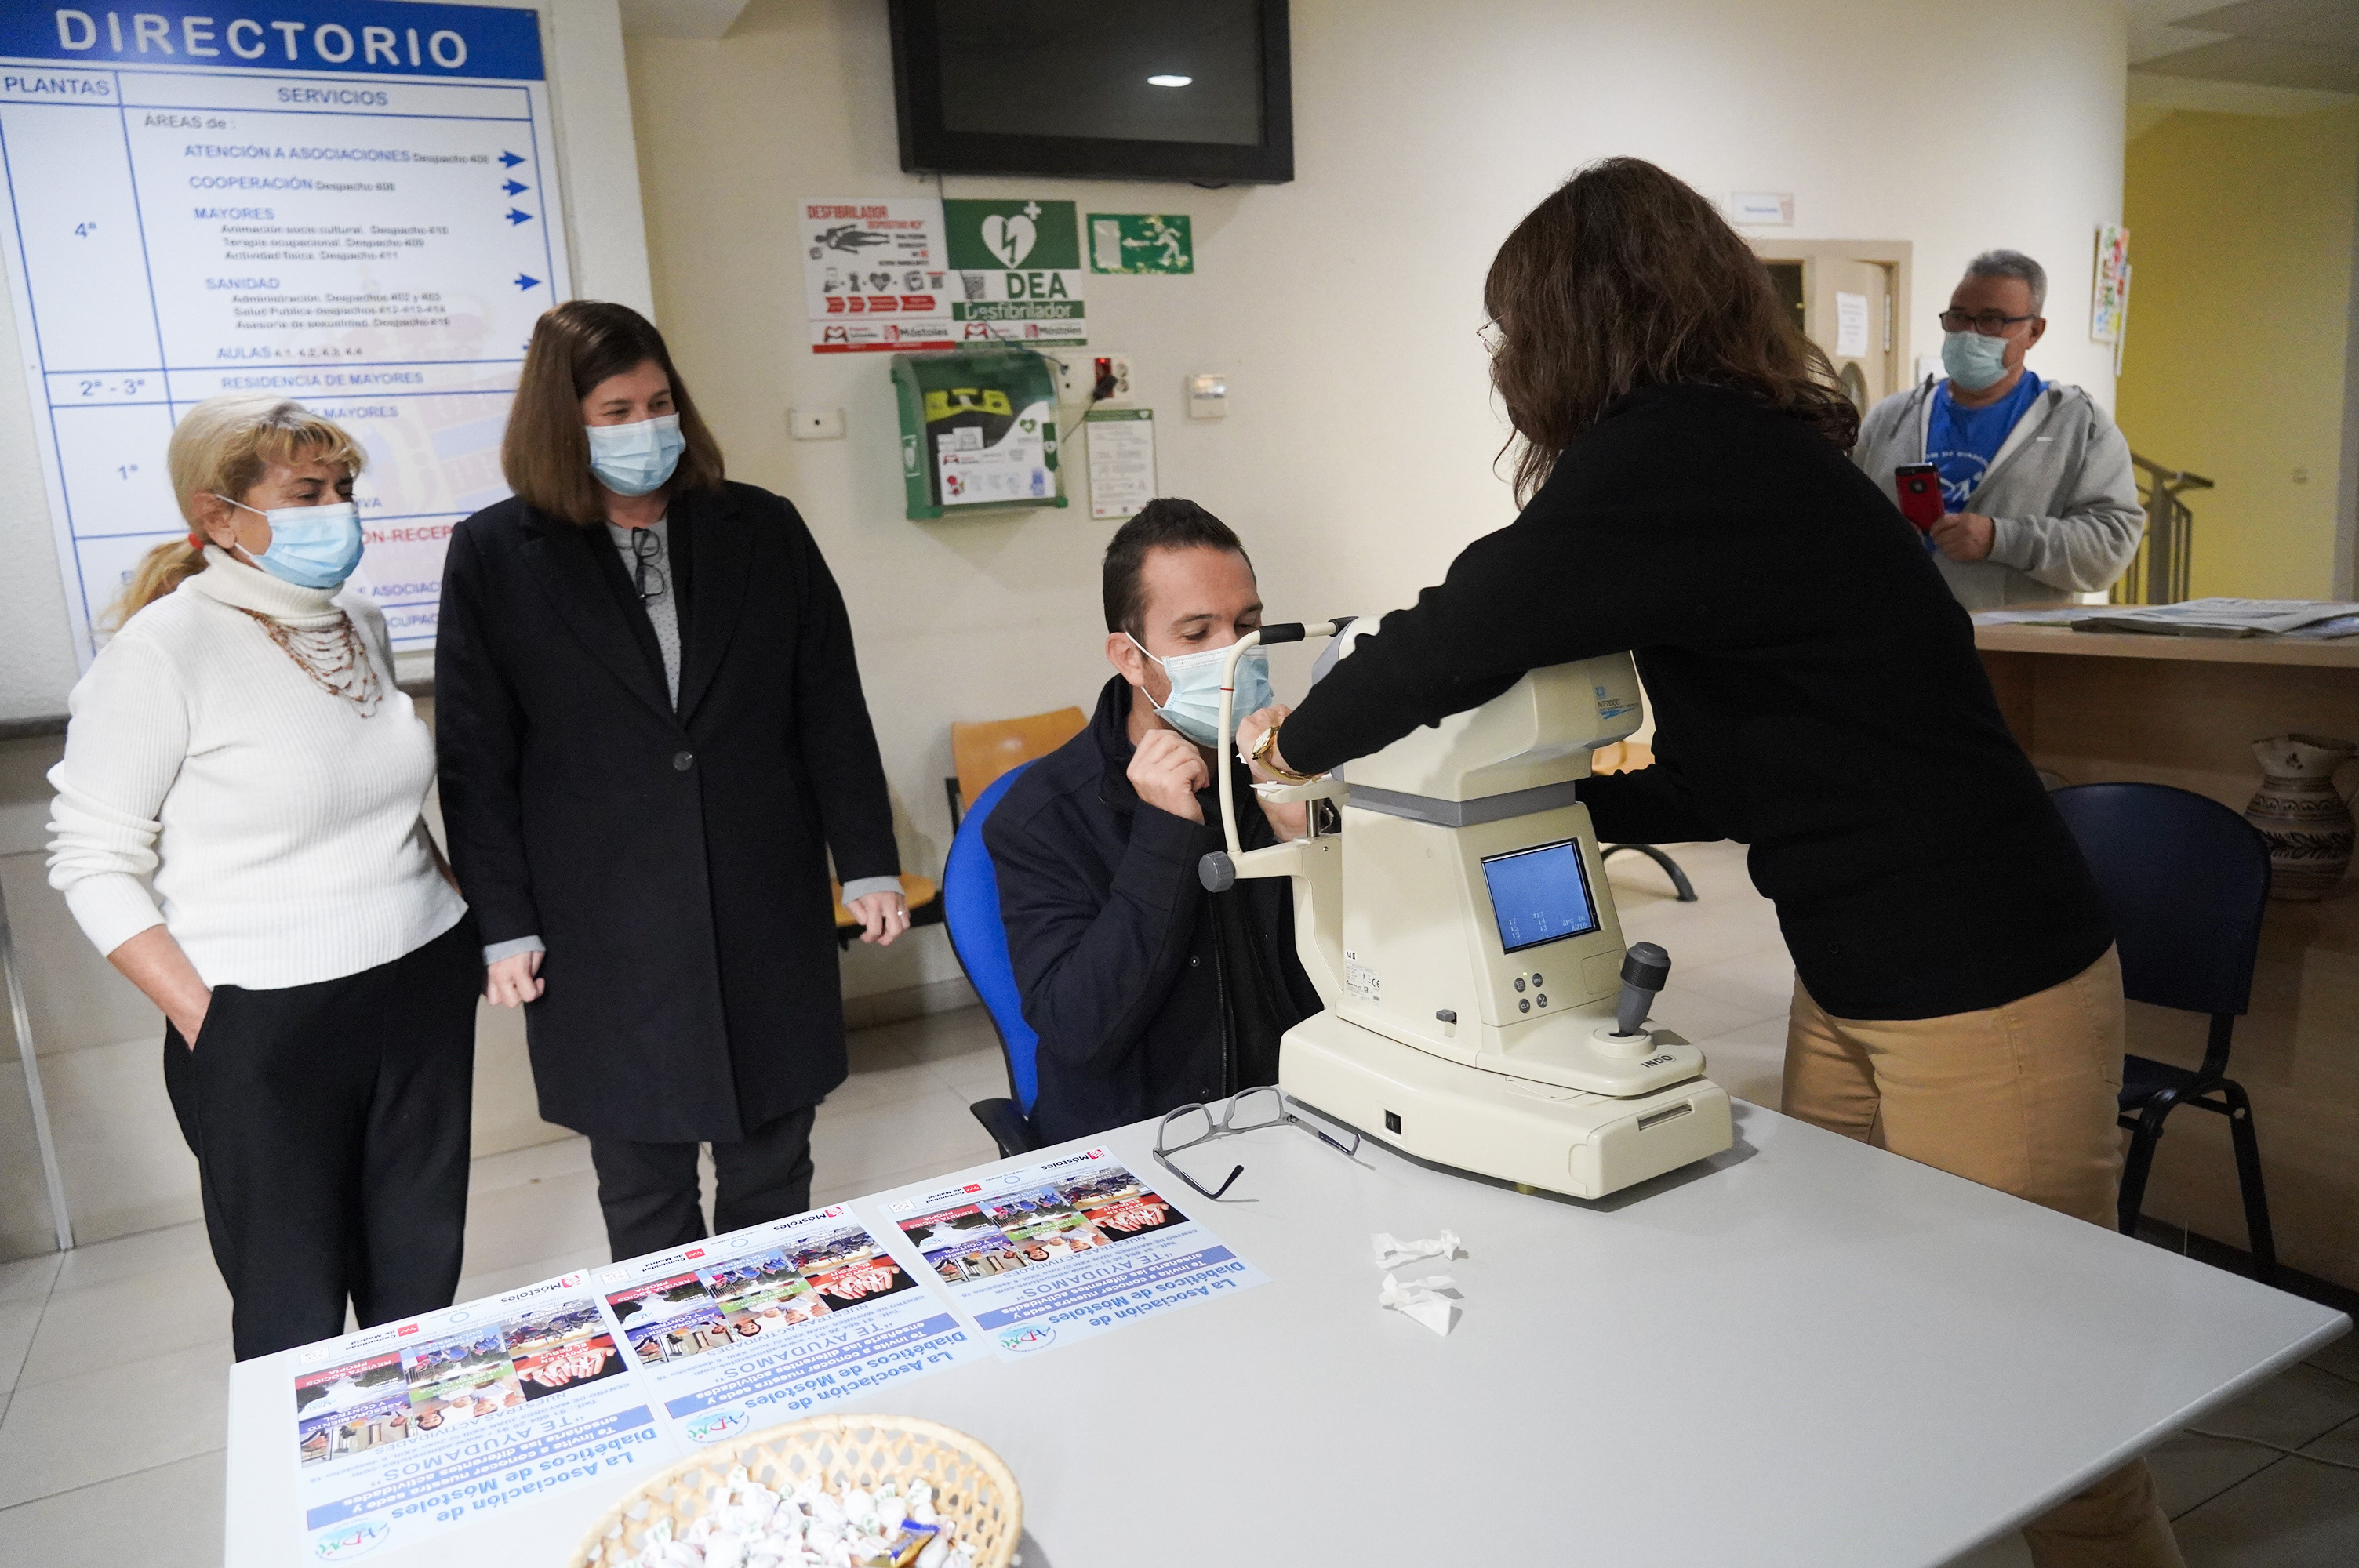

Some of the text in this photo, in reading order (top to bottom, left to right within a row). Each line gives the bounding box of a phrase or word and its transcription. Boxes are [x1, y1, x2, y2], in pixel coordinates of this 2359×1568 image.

[56, 9, 468, 69] DIRECTORIO
[2, 75, 110, 96] PLANTAS
[278, 87, 388, 106] SERVICIOS
[205, 118, 227, 129] de
[185, 144, 271, 158] ATENCIÓN
[274, 147, 285, 158] A
[289, 147, 410, 162] ASOCIACIONES
[189, 176, 313, 190] COOPERACIÓN
[195, 207, 275, 220] MAYORES
[205, 278, 280, 290] SANIDAD
[1006, 272, 1067, 299] DEA
[964, 303, 1073, 320] Desfibrilador
[217, 347, 272, 360] AULAS
[221, 372, 424, 390] RESIDENCIA DE MAYORES
[323, 405, 398, 419] MAYORES
[1641, 1055, 1673, 1068] INDO
[1039, 1154, 1092, 1172] Móstoles
[924, 1190, 965, 1203] Comunidad
[926, 1190, 952, 1199] Madrid
[1101, 1201, 1129, 1211] DEBUT
[1118, 1202, 1144, 1211] APOYO
[772, 1212, 829, 1233] Móstoles
[907, 1209, 974, 1229] REVISTA SOCIOS
[921, 1210, 954, 1221] PROPIA
[932, 1239, 1005, 1261] ASESORAMIENTO
[940, 1240, 982, 1254] CONTROL
[1001, 1235, 1147, 1279] NUESTRAS ACTIVIDADES
[1189, 1259, 1206, 1268] Te
[1000, 1252, 1204, 1315] enseñarte las diferentes actividades
[1099, 1276, 1147, 1294] conocer
[500, 1282, 564, 1307] Móstoles
[1046, 1261, 1246, 1327] Diabéticos de Móstoles
[1053, 1290, 1100, 1308] nuestra
[1087, 1278, 1237, 1328] La Asociación de
[1022, 1304, 1053, 1317] sede
[908, 1330, 926, 1339] Te
[695, 1321, 925, 1400] enseñarte las diferentes actividades
[806, 1350, 860, 1372] conocer
[743, 1330, 968, 1412] Diabéticos de Móstoles
[754, 1368, 805, 1390] nuestra
[786, 1350, 954, 1414] La Asociación de
[705, 1396, 716, 1405] y
[718, 1385, 753, 1402] sede
[597, 1425, 616, 1436] Te
[343, 1414, 619, 1508] enseñarte las diferentes actividades
[473, 1449, 536, 1475] conocer
[391, 1426, 657, 1523] Diabéticos de Móstoles
[410, 1470, 470, 1497] nuestra
[435, 1450, 634, 1526] La Asociación de
[351, 1504, 362, 1513] y
[366, 1490, 405, 1510] sede
